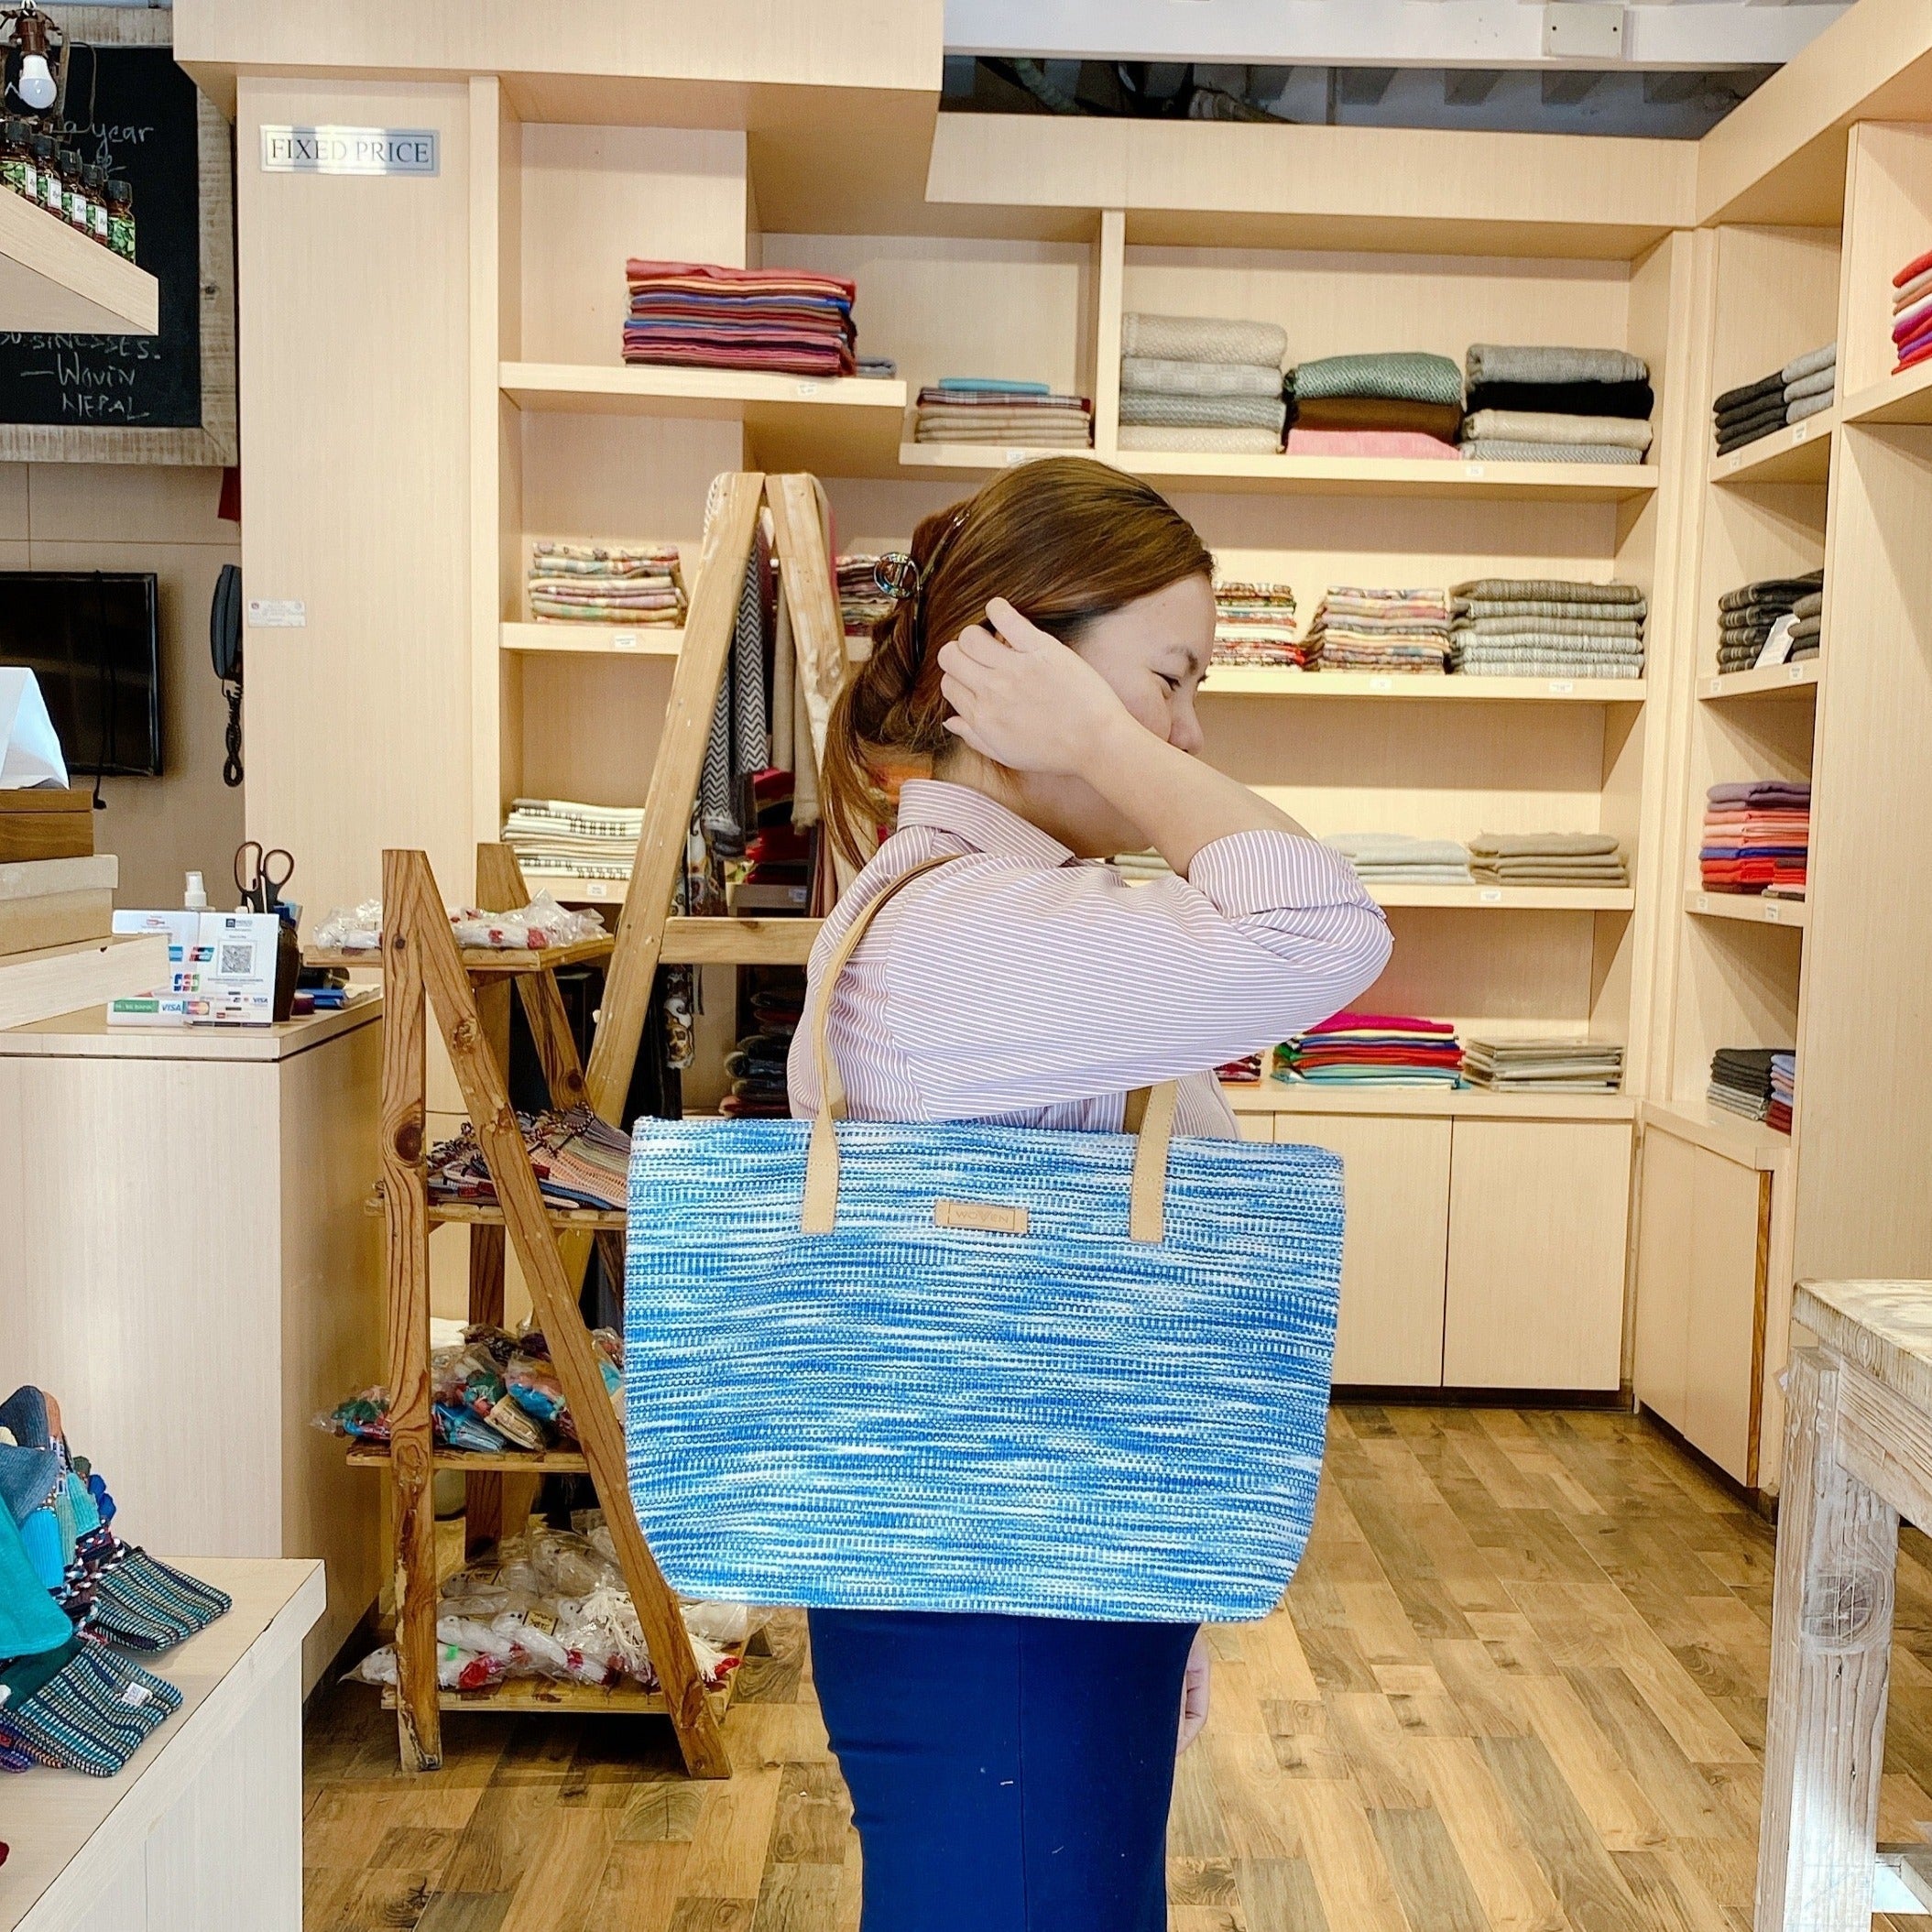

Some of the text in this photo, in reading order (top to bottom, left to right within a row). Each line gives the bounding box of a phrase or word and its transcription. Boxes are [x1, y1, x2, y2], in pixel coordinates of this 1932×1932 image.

[92, 122, 154, 159] year
[272, 138, 430, 163] FIXED PRICE
[62, 392, 150, 420] NEPAL
[161, 1003, 182, 1012] VISA
[955, 1209, 1010, 1224] WOVEN
